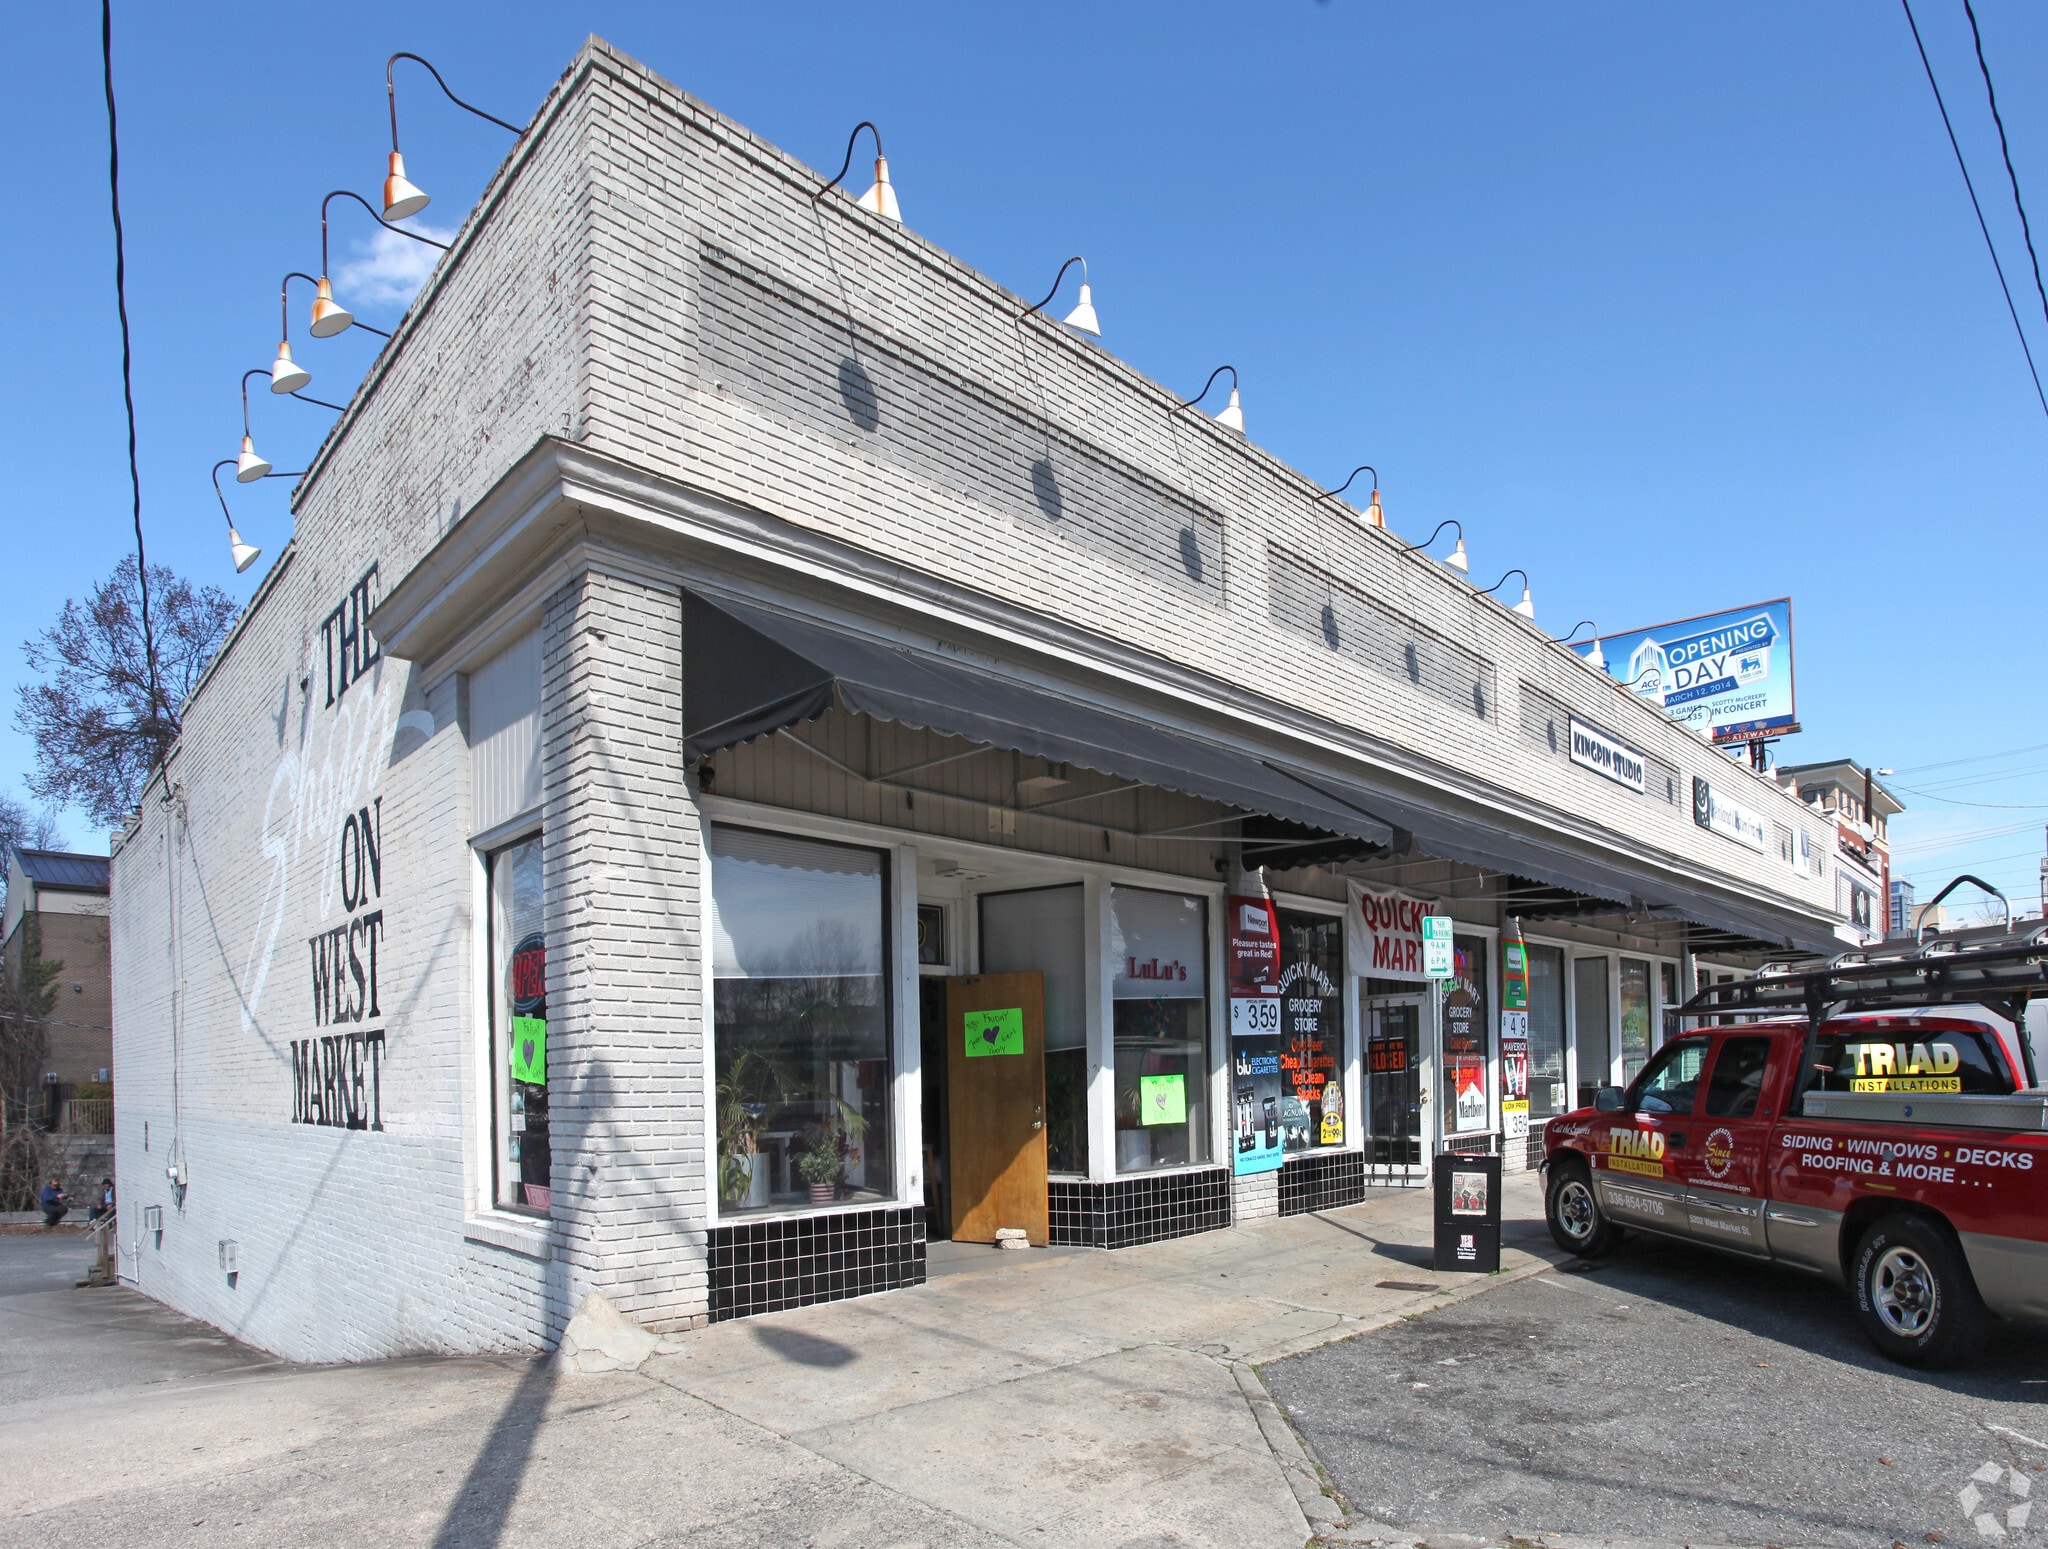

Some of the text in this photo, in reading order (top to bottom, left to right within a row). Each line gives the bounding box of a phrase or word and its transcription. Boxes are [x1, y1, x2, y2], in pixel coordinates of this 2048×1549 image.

[321, 561, 380, 710] THE
[1669, 621, 1768, 666] OPENING
[1735, 643, 1761, 653] PRESENTED
[1675, 655, 1726, 689] DAY
[1641, 679, 1659, 689] ACC
[1710, 681, 1731, 693] 2014
[1711, 699, 1767, 716] IN CONCERT
[1712, 692, 1767, 707] SCOTTY McCREERY
[1676, 704, 1702, 715] GAMES
[1688, 712, 1703, 721] $35
[1574, 730, 1643, 785] KINGPIN STUDIO
[341, 795, 383, 913] ON
[1247, 914, 1268, 929] Newport
[1232, 938, 1277, 949] Pleasure tastes
[1237, 949, 1273, 959] great in Red!
[308, 908, 385, 1027] WEST
[1129, 956, 1187, 981] LuLu's
[1279, 961, 1335, 997] QUICKY MART
[1463, 977, 1481, 1005] MART
[1289, 998, 1322, 1013] GROCERY
[1449, 1006, 1473, 1018] GROCERY
[982, 1010, 1008, 1023] FRIDAY
[1234, 1004, 1278, 1031] $ 3.59
[1294, 1017, 1318, 1032] STORE
[1453, 1022, 1470, 1034] STORE
[1291, 1037, 1324, 1052] Cold Beer
[1503, 1042, 1527, 1051] MAVERICK
[1236, 1057, 1278, 1075] blu ELECTRONIC
[1280, 1054, 1335, 1071] Cheap Cigarettes
[1845, 1043, 1960, 1076] TRIAD
[1252, 1065, 1278, 1075] CIGARETTES
[1292, 1070, 1325, 1085] Ice Cream
[290, 1028, 387, 1132] MARKET
[1851, 1080, 1959, 1092] INSTALLATIONS
[1296, 1086, 1320, 1101] Snacks
[1282, 1108, 1305, 1118] AGNUM
[1459, 1096, 1485, 1119] Marlboro
[1515, 1101, 1527, 1109] PRICE
[1552, 1122, 1564, 1133] Call
[1570, 1122, 1591, 1137] Experts
[1609, 1126, 1665, 1160] TRIAD
[1705, 1127, 1734, 1149] SATISFACTION
[1705, 1142, 1731, 1158] Since
[1782, 1134, 2034, 1170] SIDING WINDOWS DECKS
[1609, 1158, 1662, 1175] INSTALLATIONS
[1704, 1159, 1731, 1178] GUARANTEED
[1801, 1153, 1874, 1174] ROOFING
[1878, 1162, 1891, 1175] &
[1896, 1163, 1955, 1183] MORE
[1688, 1177, 1751, 1193] www.triadinstallations.com
[1689, 1214, 1751, 1236] 5202 West Market St.
